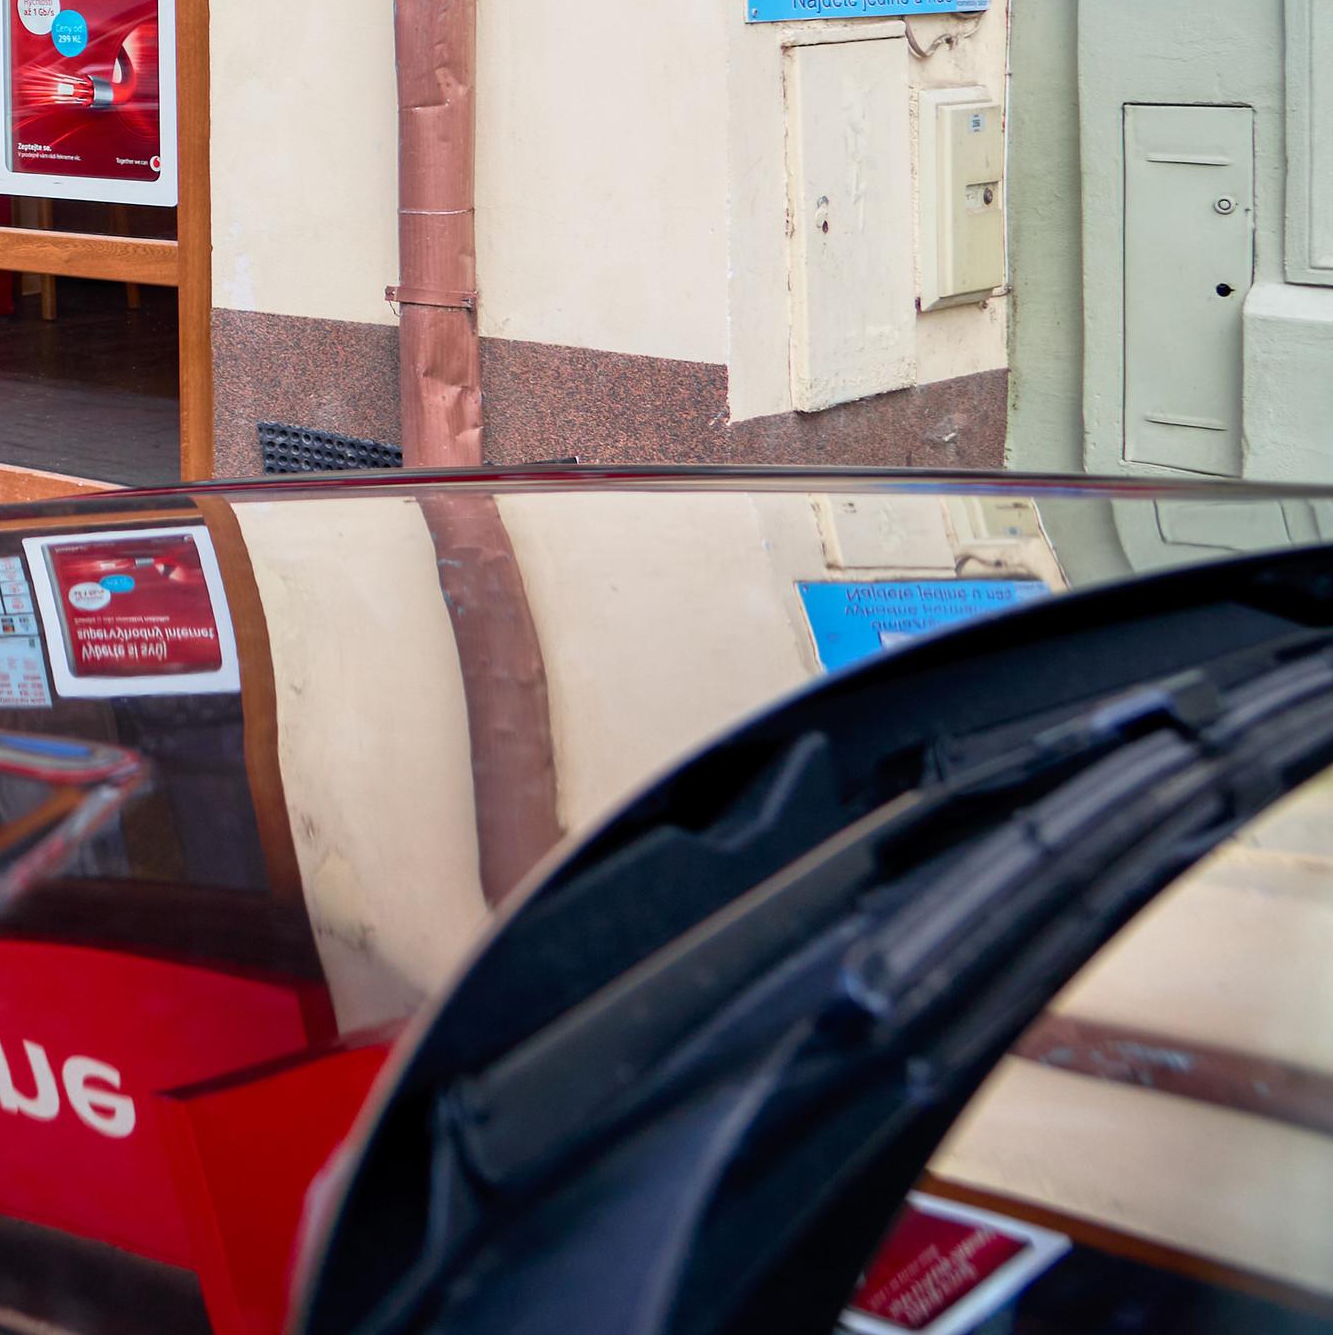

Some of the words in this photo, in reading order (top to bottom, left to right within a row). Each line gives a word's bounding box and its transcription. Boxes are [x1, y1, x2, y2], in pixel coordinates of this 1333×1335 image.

[23, 7, 32, 17] až
[38, 7, 55, 17] Gb/s
[55, 23, 72, 34] Ceny
[17, 142, 42, 153] Zeptejte
